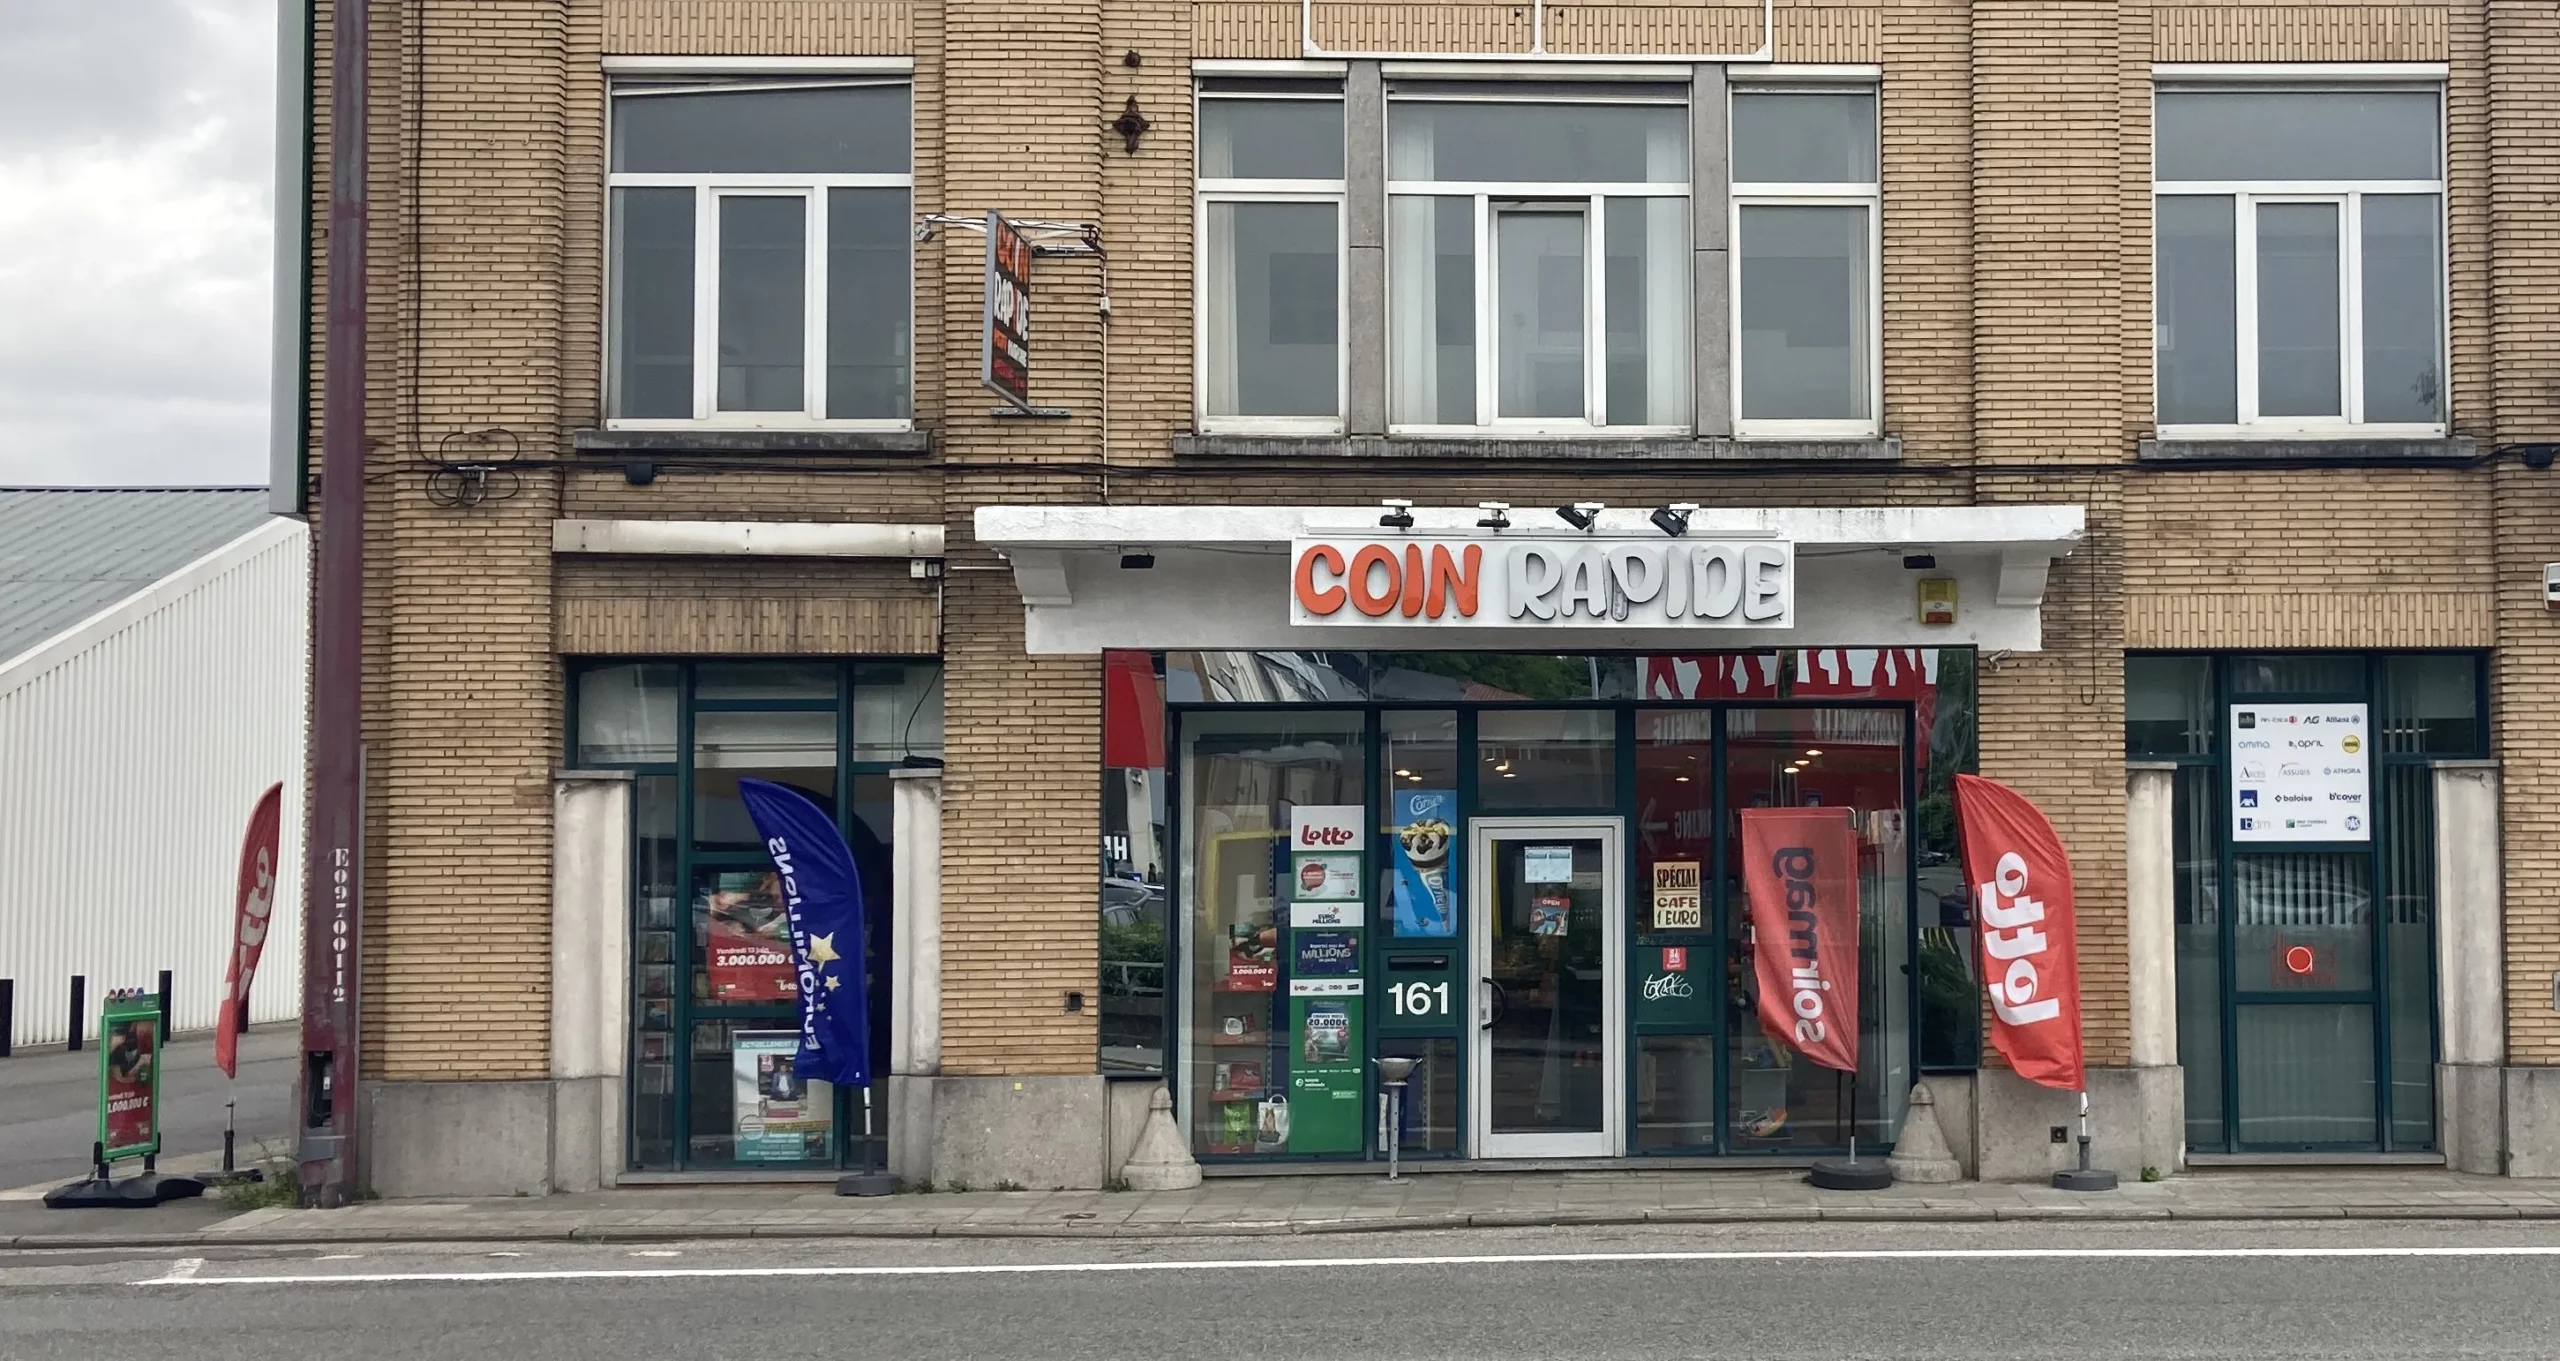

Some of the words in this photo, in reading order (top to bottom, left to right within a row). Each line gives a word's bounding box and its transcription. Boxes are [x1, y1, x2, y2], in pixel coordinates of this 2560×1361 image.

[1295, 543, 1483, 618] COIN
[1507, 544, 1785, 622] RAPIDE
[2303, 716, 2320, 724] AG
[2238, 741, 2270, 749] amma
[2298, 740, 2324, 749] april
[2283, 794, 2313, 802] baloise
[1657, 865, 1698, 888] SPÉCIAL
[1657, 897, 1698, 908] CAFE
[1657, 910, 1661, 925] 1
[1665, 910, 1699, 925] EURO
[1302, 948, 1351, 959] MILLIONS
[716, 954, 785, 966] 3.000.000
[1388, 981, 1448, 1015] 161
[1308, 1018, 1348, 1027] 20.000€
